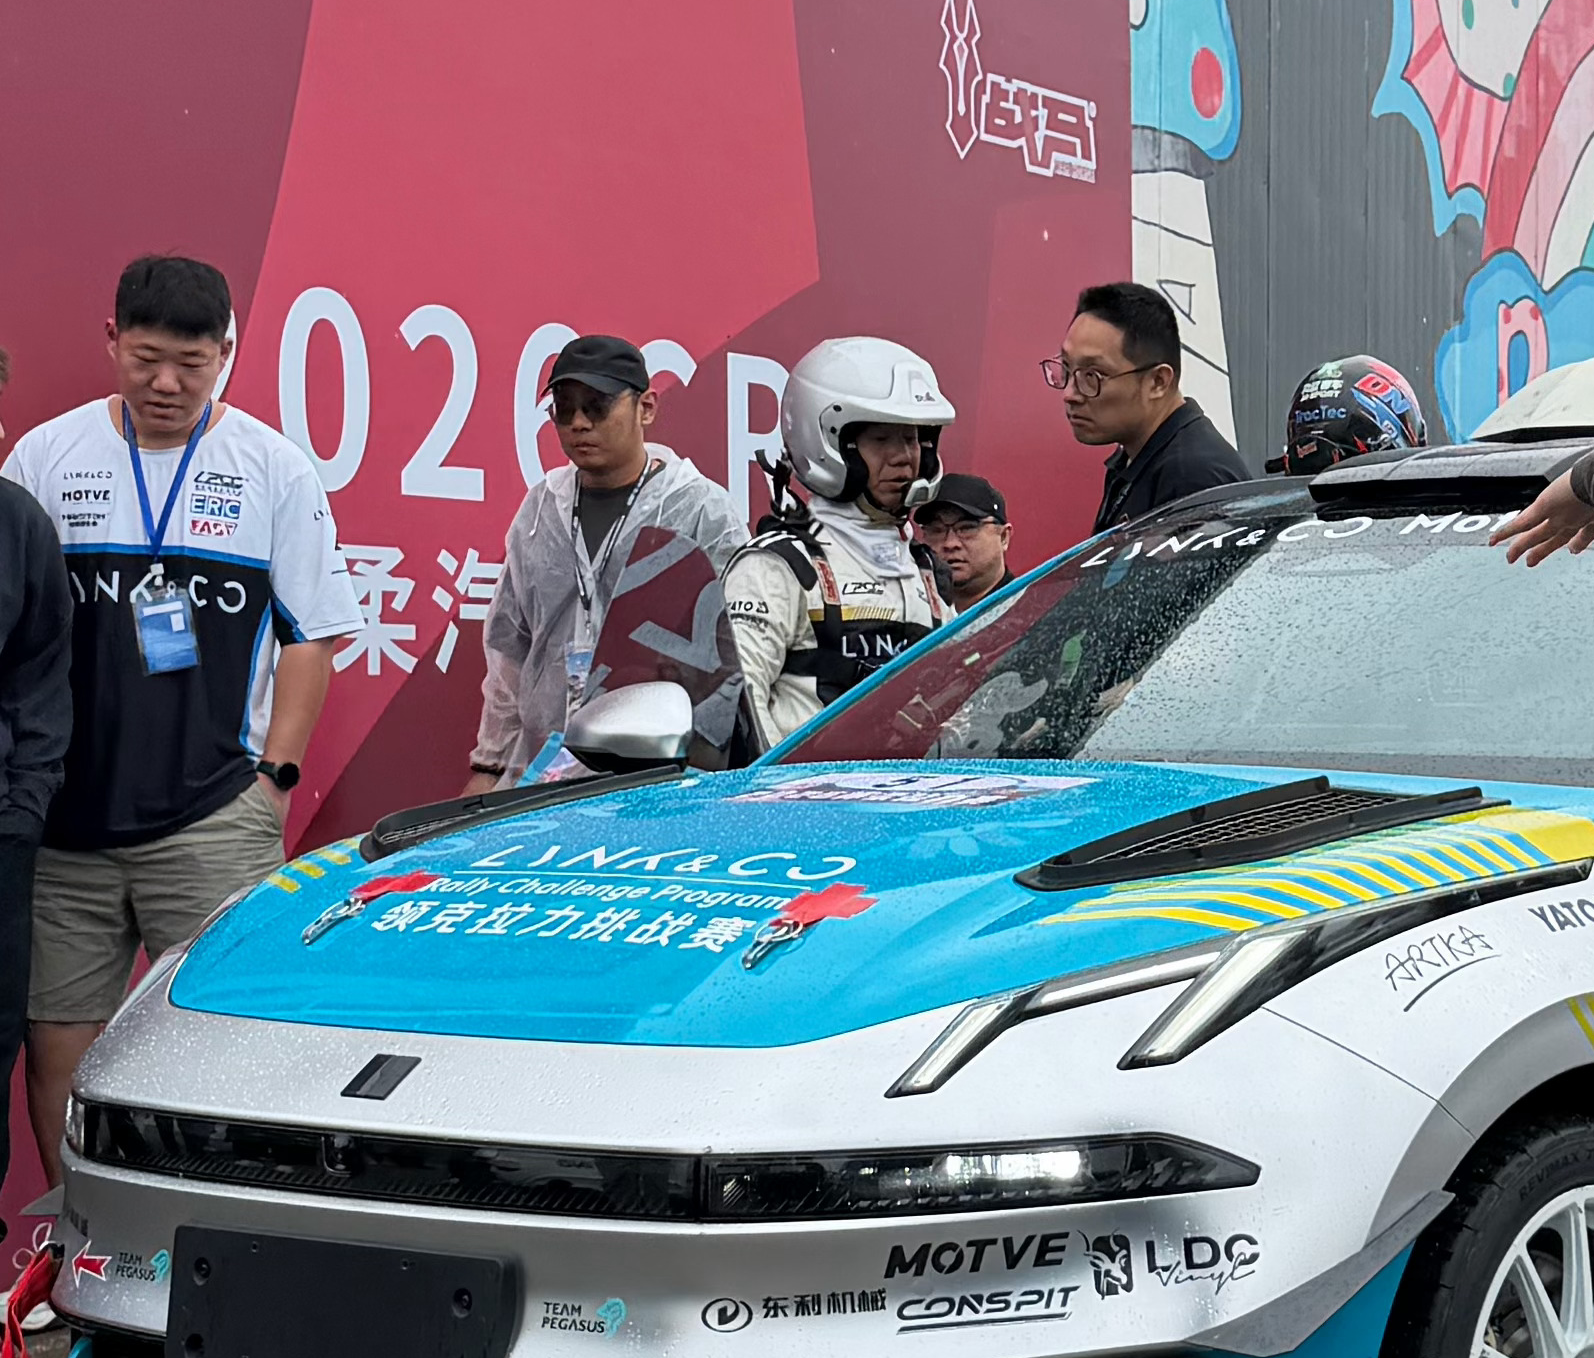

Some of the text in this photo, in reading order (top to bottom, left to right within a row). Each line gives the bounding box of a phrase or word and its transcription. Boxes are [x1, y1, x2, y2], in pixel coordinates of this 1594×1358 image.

[191, 494, 242, 519] ERC
[1081, 516, 1373, 568] LINK&CO
[470, 844, 857, 881] LINK&CO
[423, 876, 785, 911] Rally Challenge Program
[371, 900, 757, 954] 领克拉力挑战赛
[1384, 924, 1494, 992] ARTKA
[118, 1252, 143, 1266] TEAM
[884, 1231, 1070, 1280] MOTVE
[1145, 1233, 1261, 1274] LDC
[115, 1266, 157, 1282] PEGASUS
[543, 1301, 583, 1317] TEAM
[762, 1287, 888, 1319] 东利机械
[896, 1284, 1081, 1321] CONSPIT
[541, 1316, 606, 1334] PEGASUS
